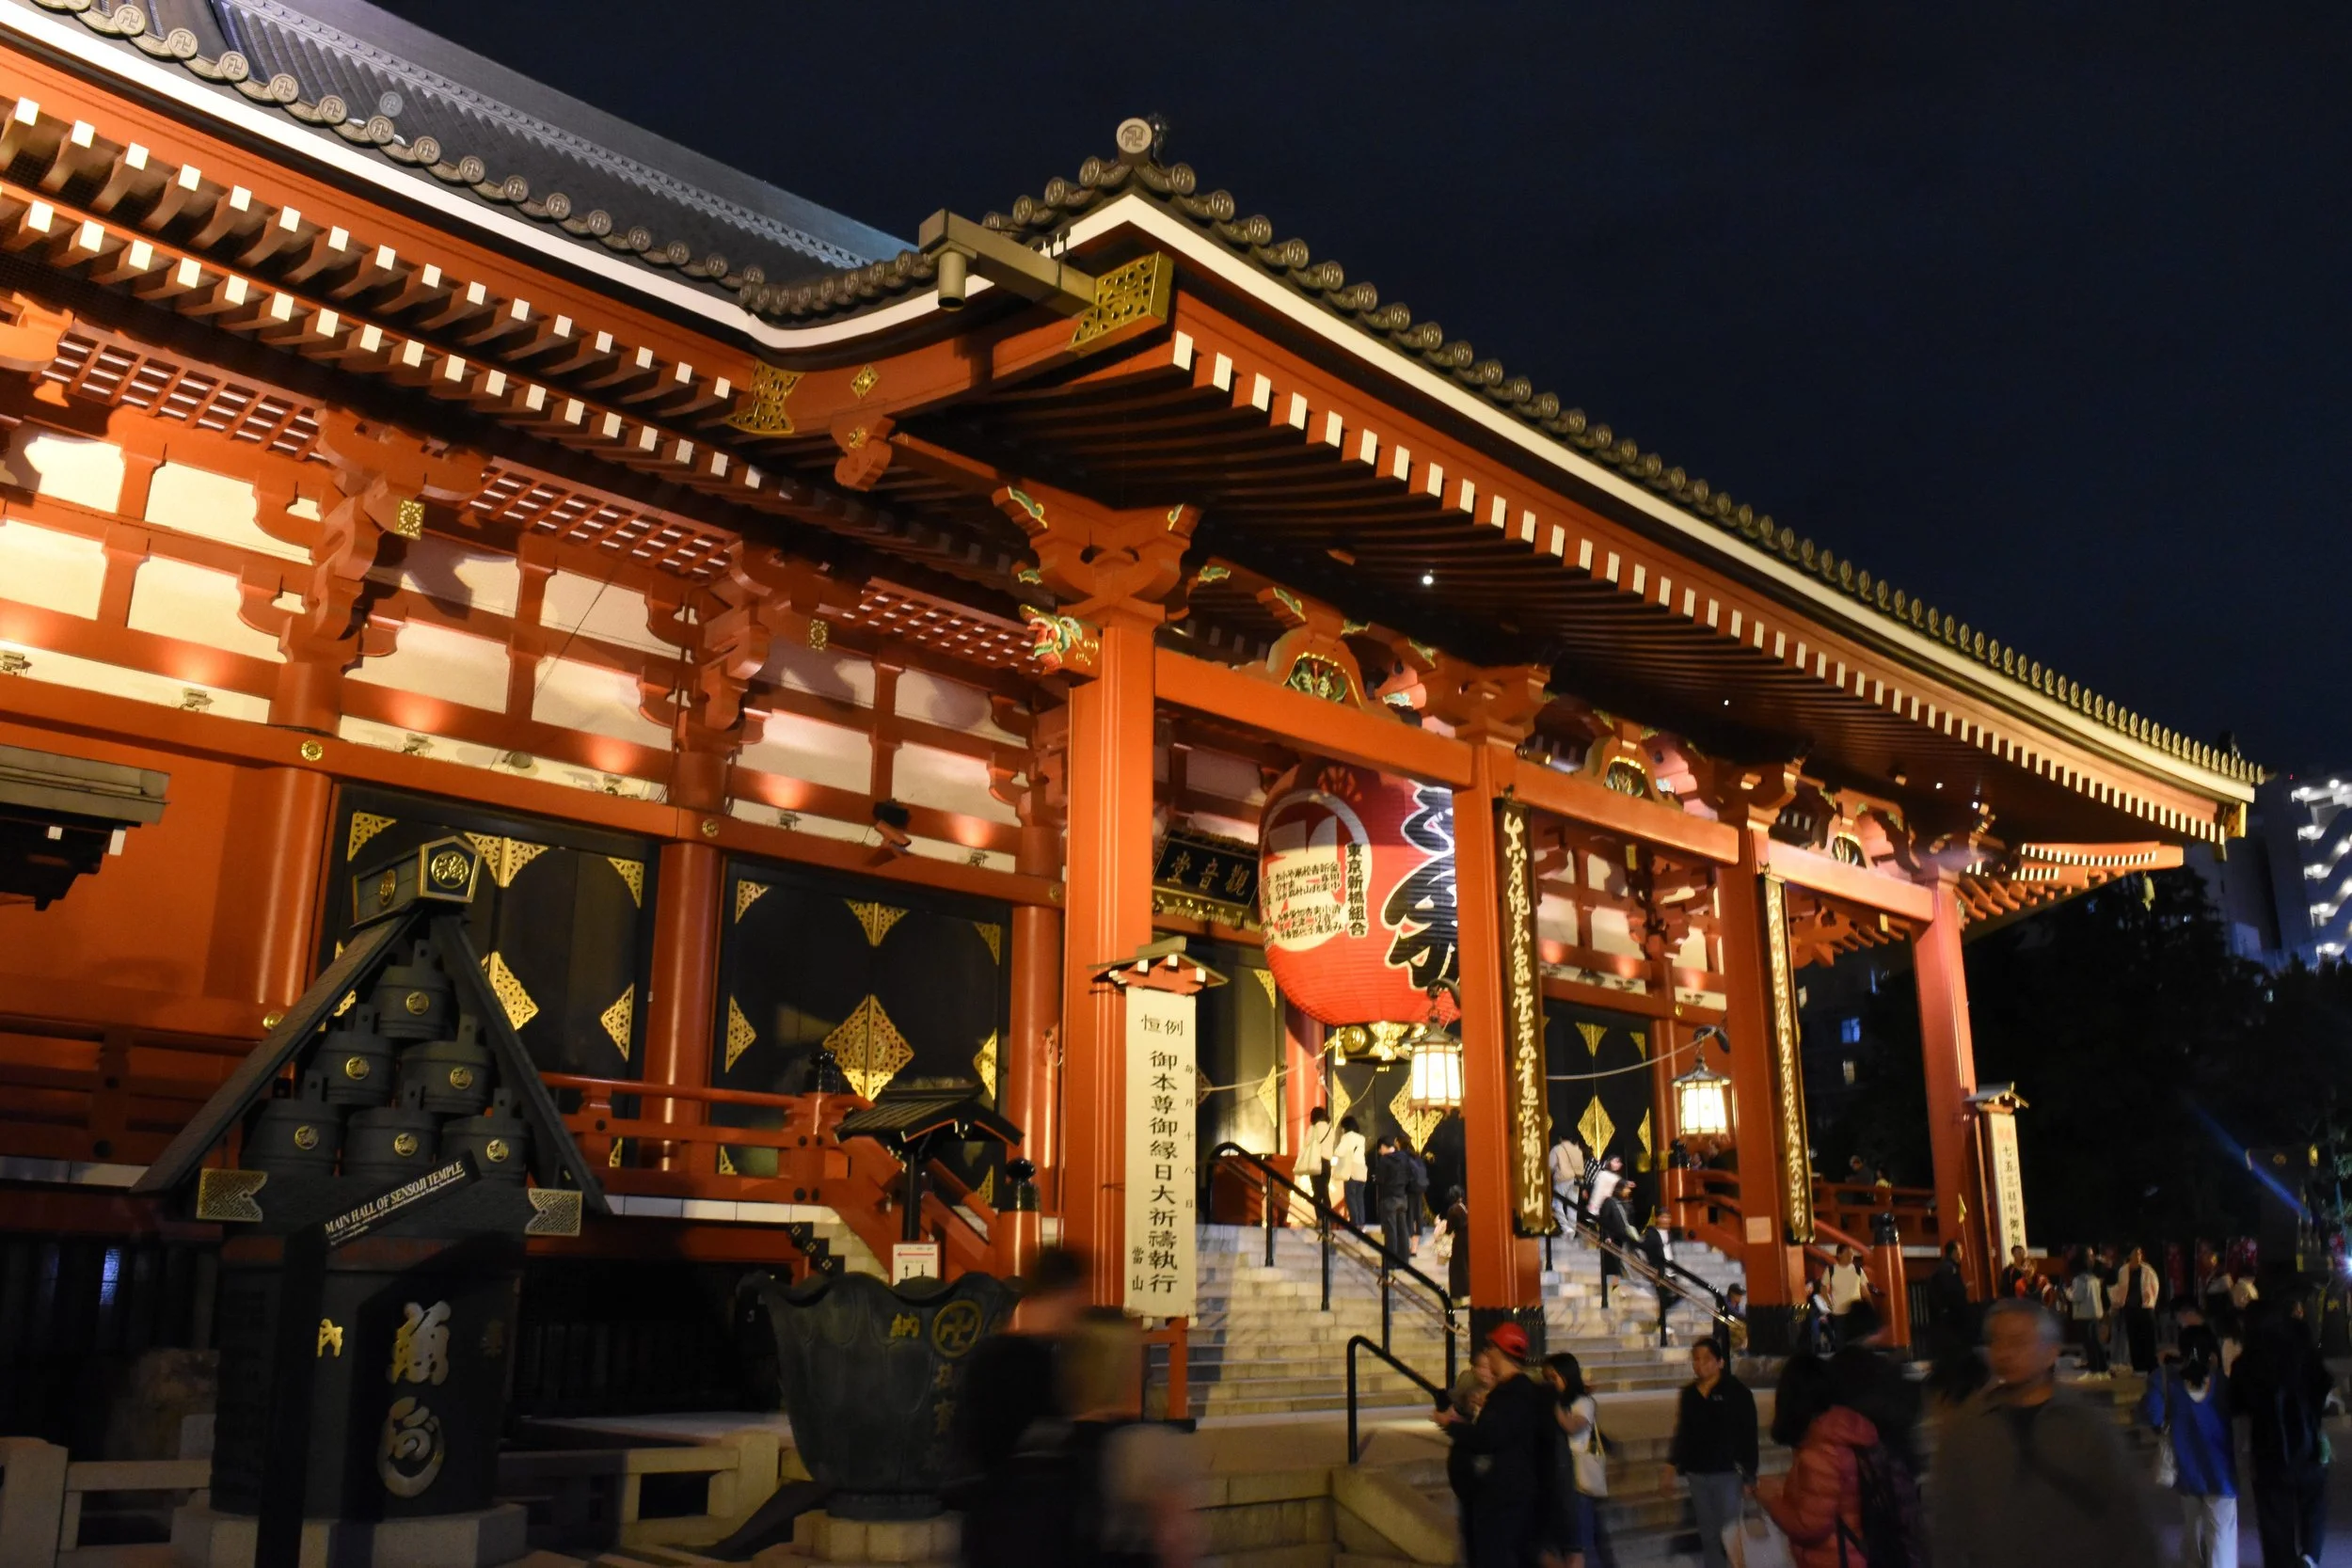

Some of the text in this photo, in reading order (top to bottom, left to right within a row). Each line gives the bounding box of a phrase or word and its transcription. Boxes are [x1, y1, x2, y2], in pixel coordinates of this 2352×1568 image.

[1346, 843, 1366, 937] 東京新橋組合
[1140, 1014, 1184, 1036] 恒例
[325, 1161, 463, 1233] MAIN HALL OF SENSOJI TEMPLE
